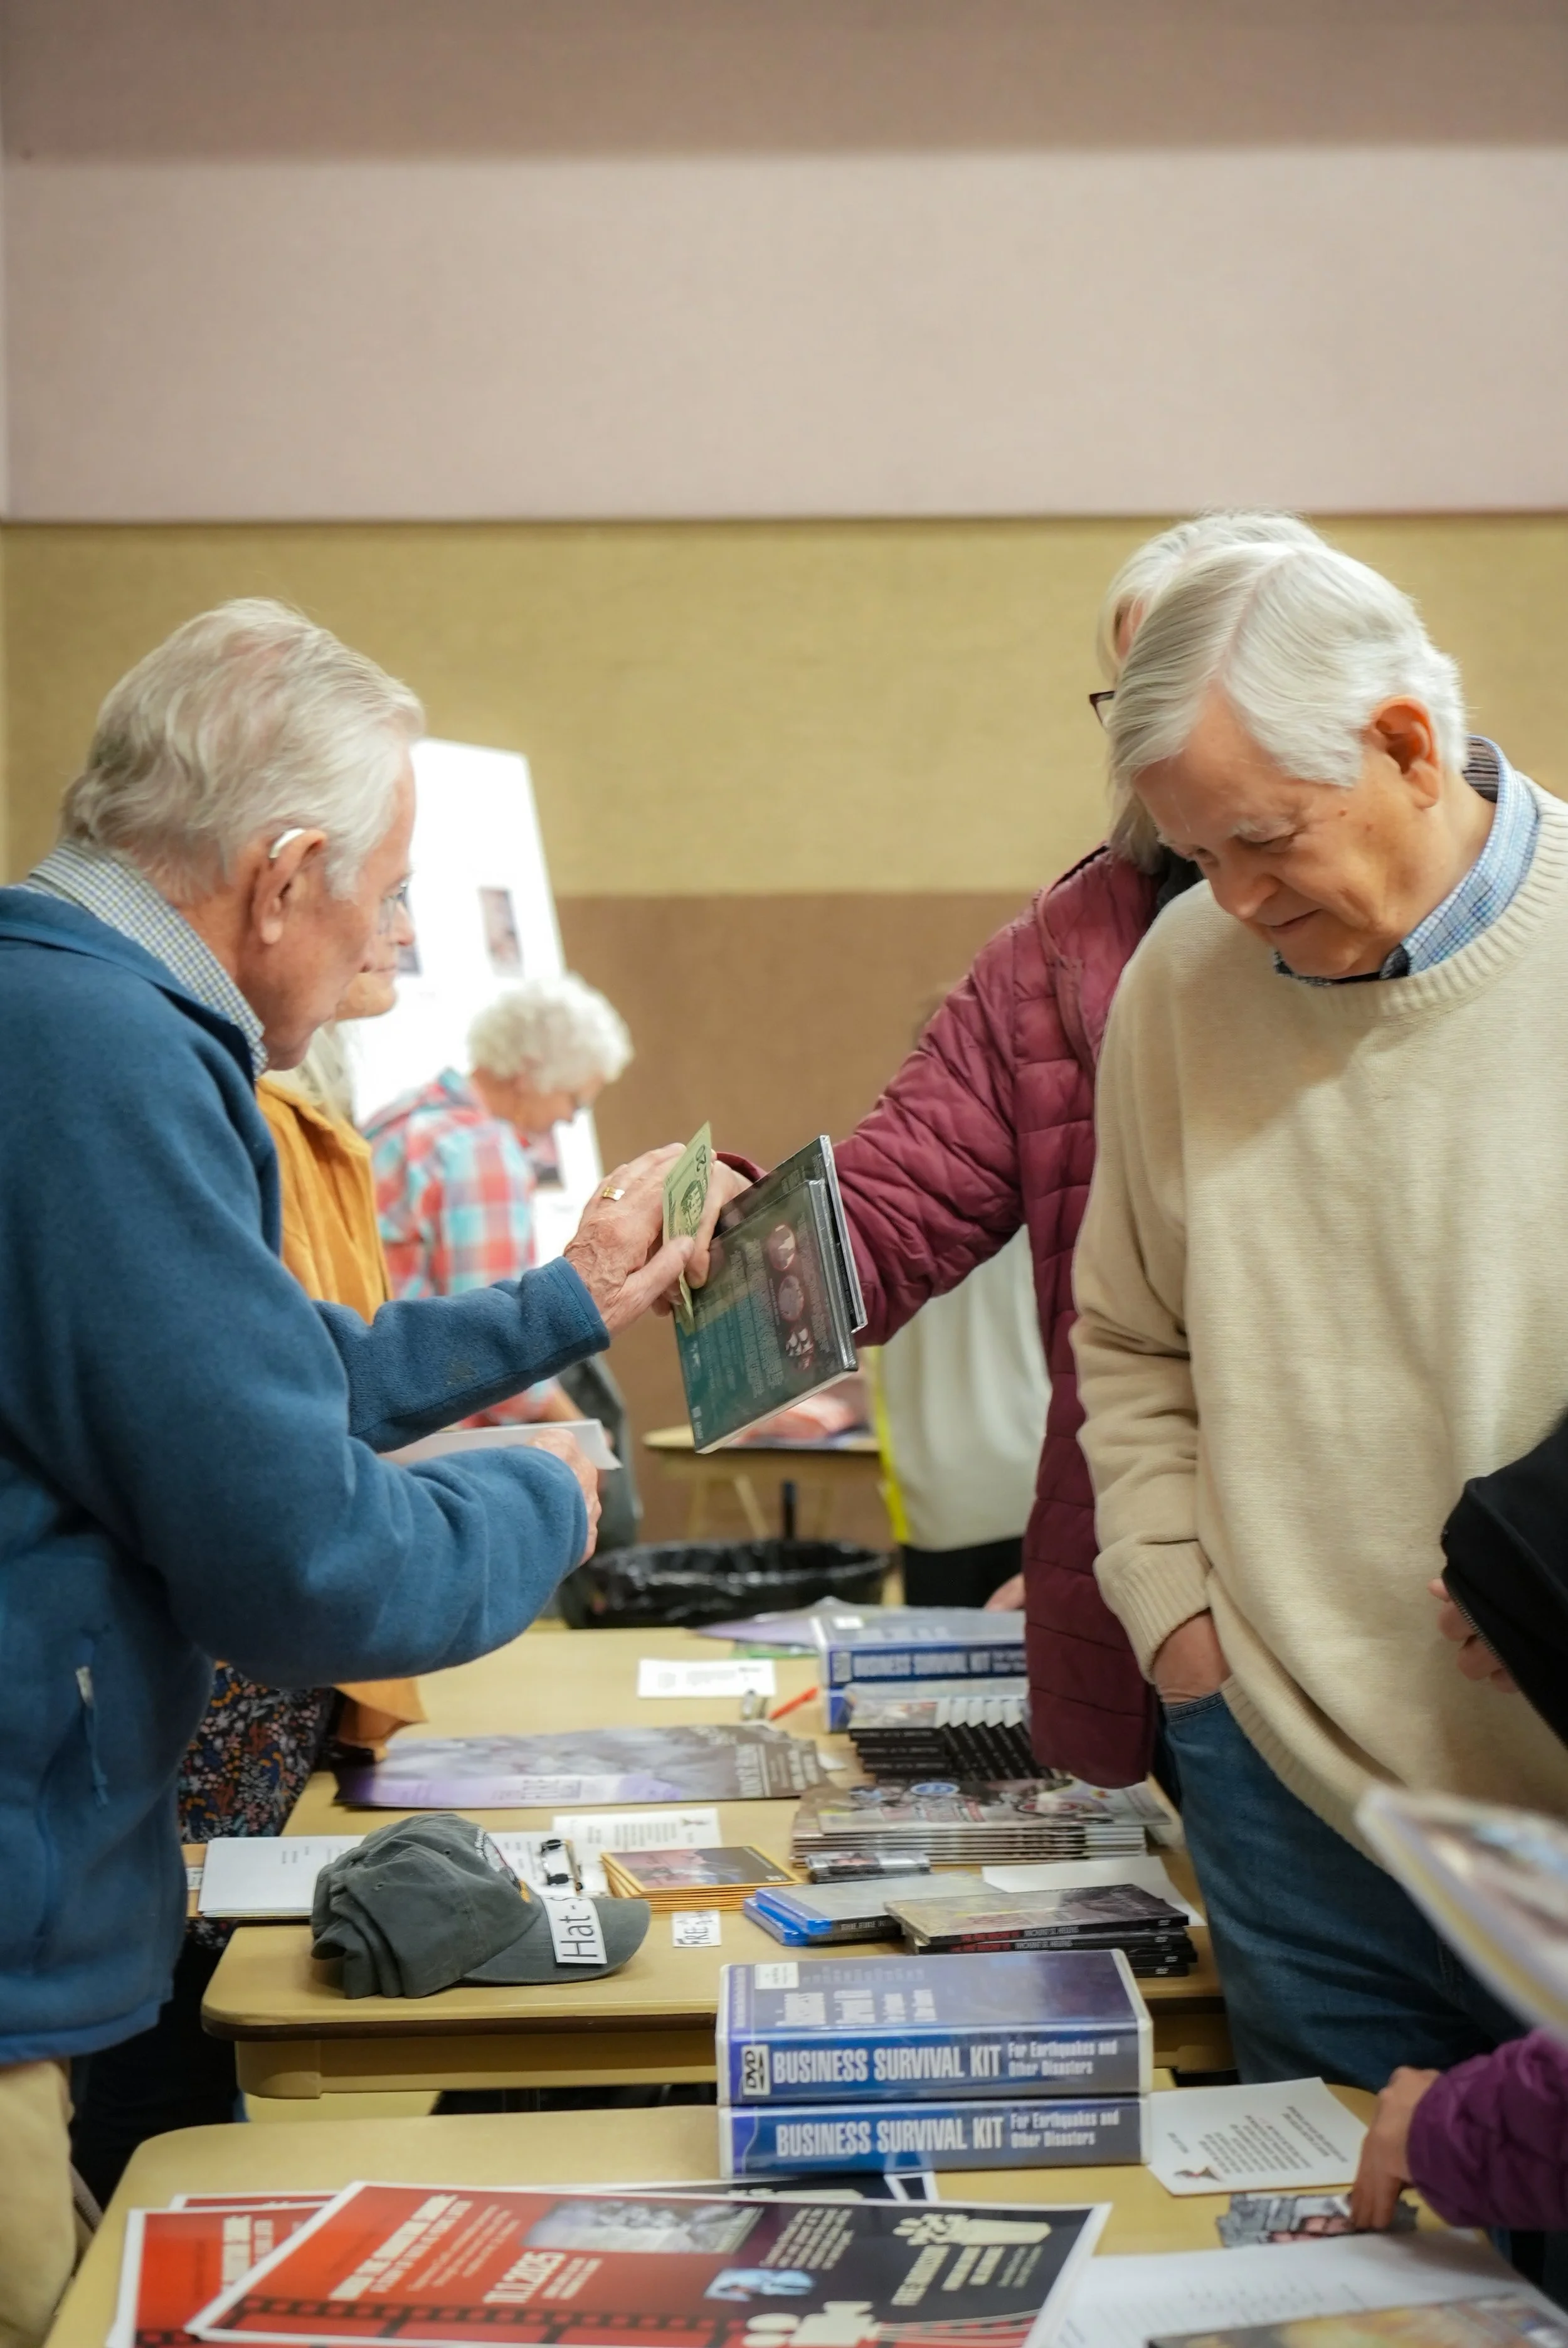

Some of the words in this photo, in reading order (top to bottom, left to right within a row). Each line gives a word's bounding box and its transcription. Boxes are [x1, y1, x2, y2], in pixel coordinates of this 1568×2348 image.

[695, 1144, 706, 1172] 20
[558, 1915, 598, 1957] Hat
[1008, 2042, 1027, 2058] For
[1030, 2040, 1095, 2058] Earthquakes
[1098, 2039, 1118, 2055] and
[745, 2051, 758, 2088] DVD
[773, 2048, 868, 2084] BUSINESS
[873, 2046, 966, 2081] SURVIVAL
[970, 2044, 1002, 2077] KIT
[1008, 2061, 1038, 2077] Other
[1041, 2060, 1093, 2076] Disasters
[1010, 2113, 1029, 2129] For
[1032, 2110, 1097, 2129] Earthquakes
[1099, 2109, 1120, 2126] and
[776, 2121, 871, 2157] BUSINESS
[876, 2118, 968, 2154] SURVIVAL
[973, 2117, 1004, 2149] KIT
[1010, 2132, 1041, 2149] Other
[1044, 2131, 1096, 2147] Disasters
